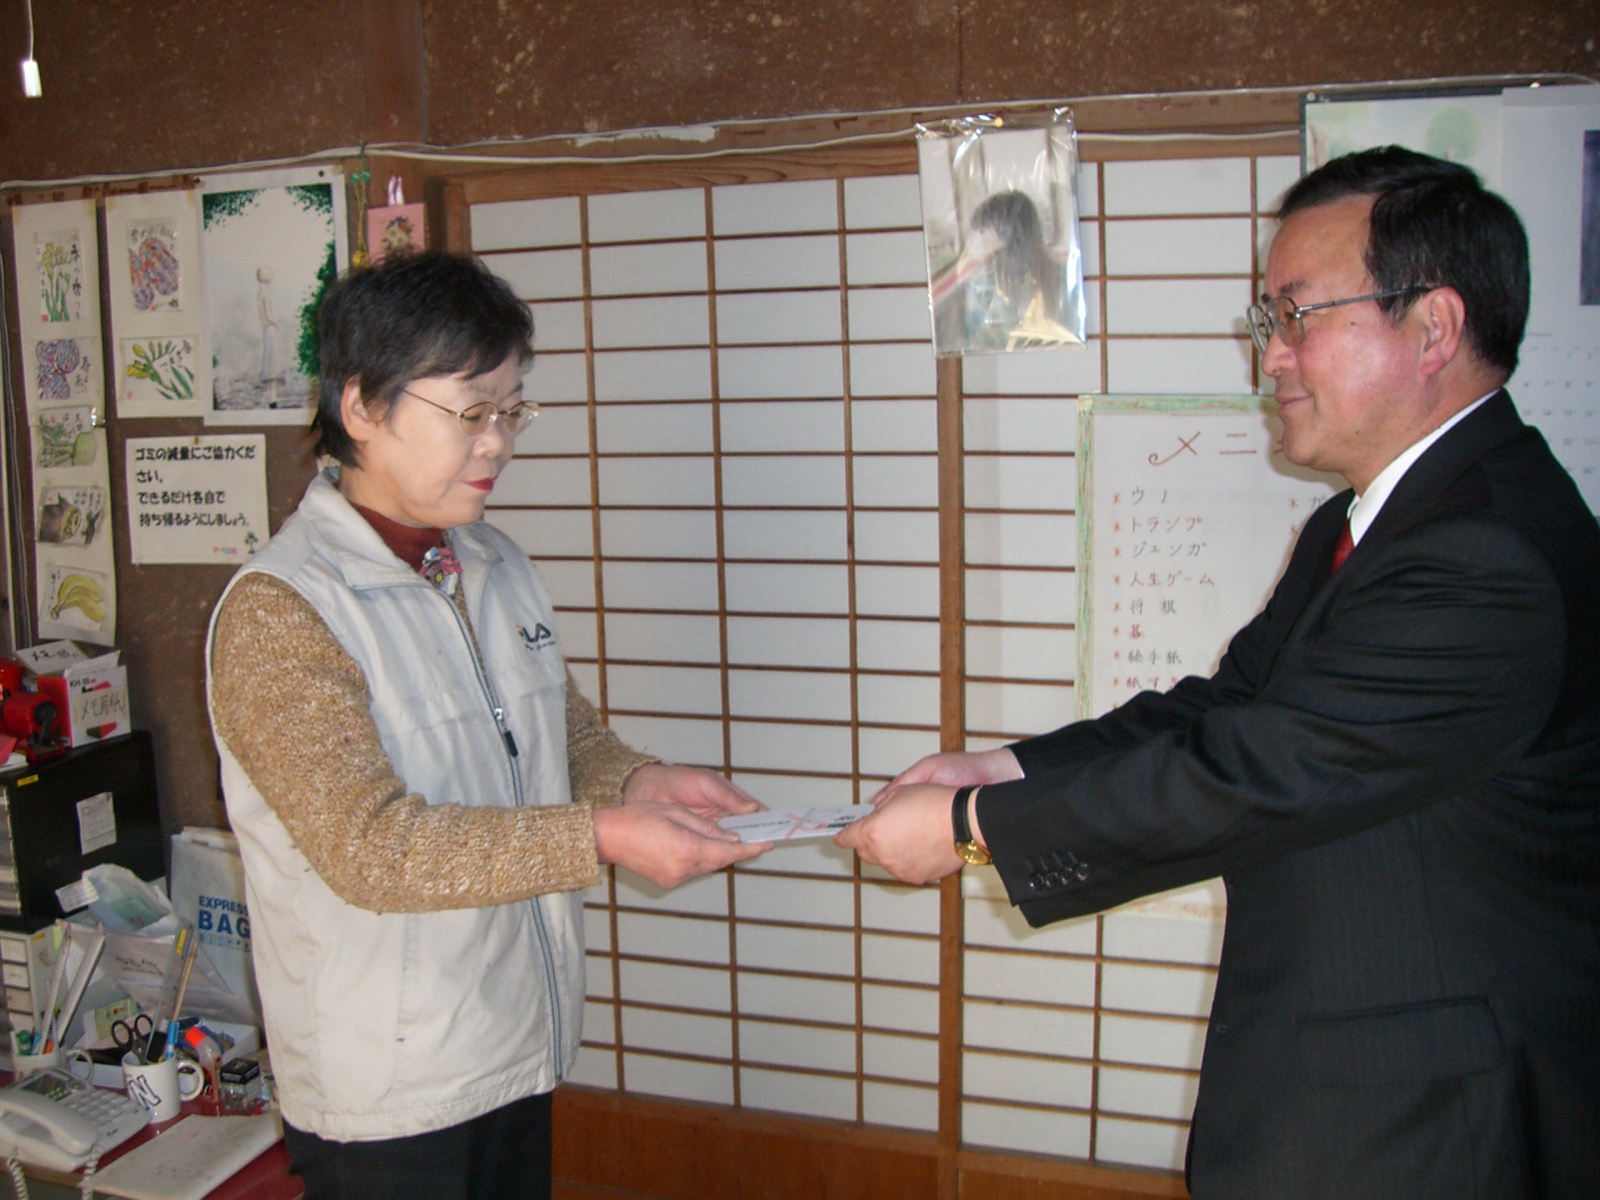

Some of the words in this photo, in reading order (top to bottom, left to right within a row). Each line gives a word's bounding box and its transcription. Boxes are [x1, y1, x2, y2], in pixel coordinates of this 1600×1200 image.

[1148, 431, 1282, 465] メニ
[1132, 516, 1203, 533] トランプ
[1130, 569, 1215, 587] 人生ゲーム
[1127, 649, 1182, 665] 絵手紙
[198, 909, 251, 939] BAG
